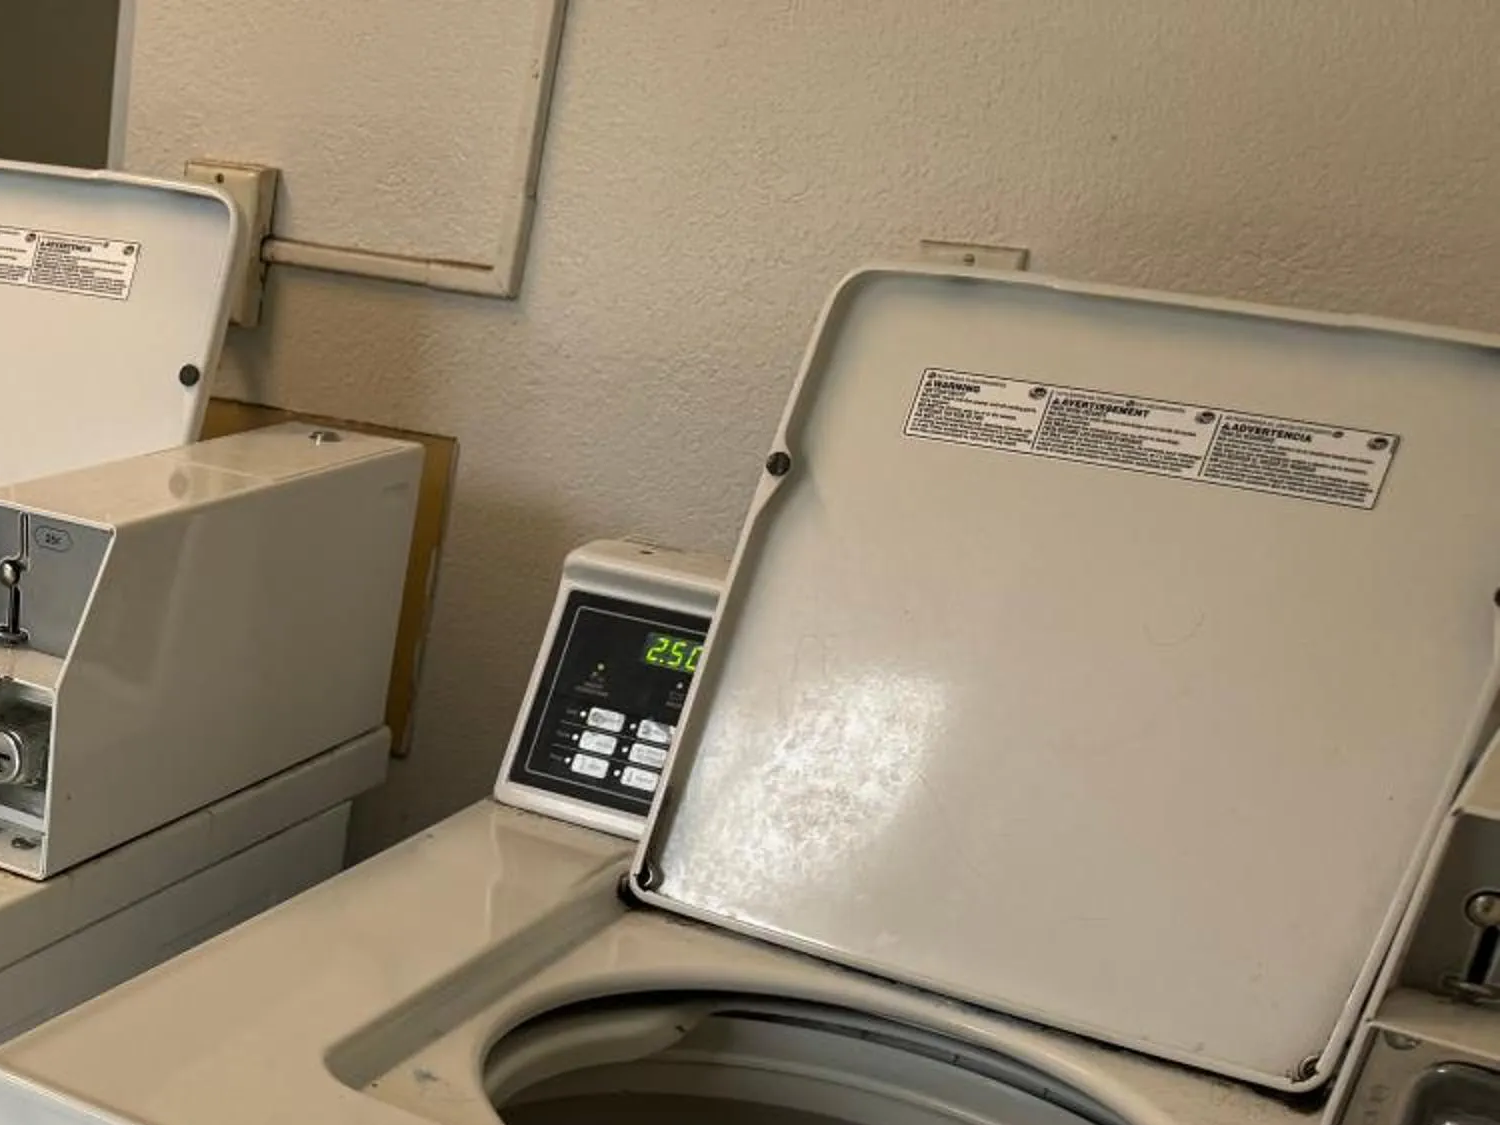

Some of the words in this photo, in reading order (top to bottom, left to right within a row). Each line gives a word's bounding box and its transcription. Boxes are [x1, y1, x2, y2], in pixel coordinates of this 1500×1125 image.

[934, 379, 981, 395] WARNING
[1061, 397, 1151, 418] AVERTISSEMENT
[1233, 422, 1313, 443] ADVERTENCIA
